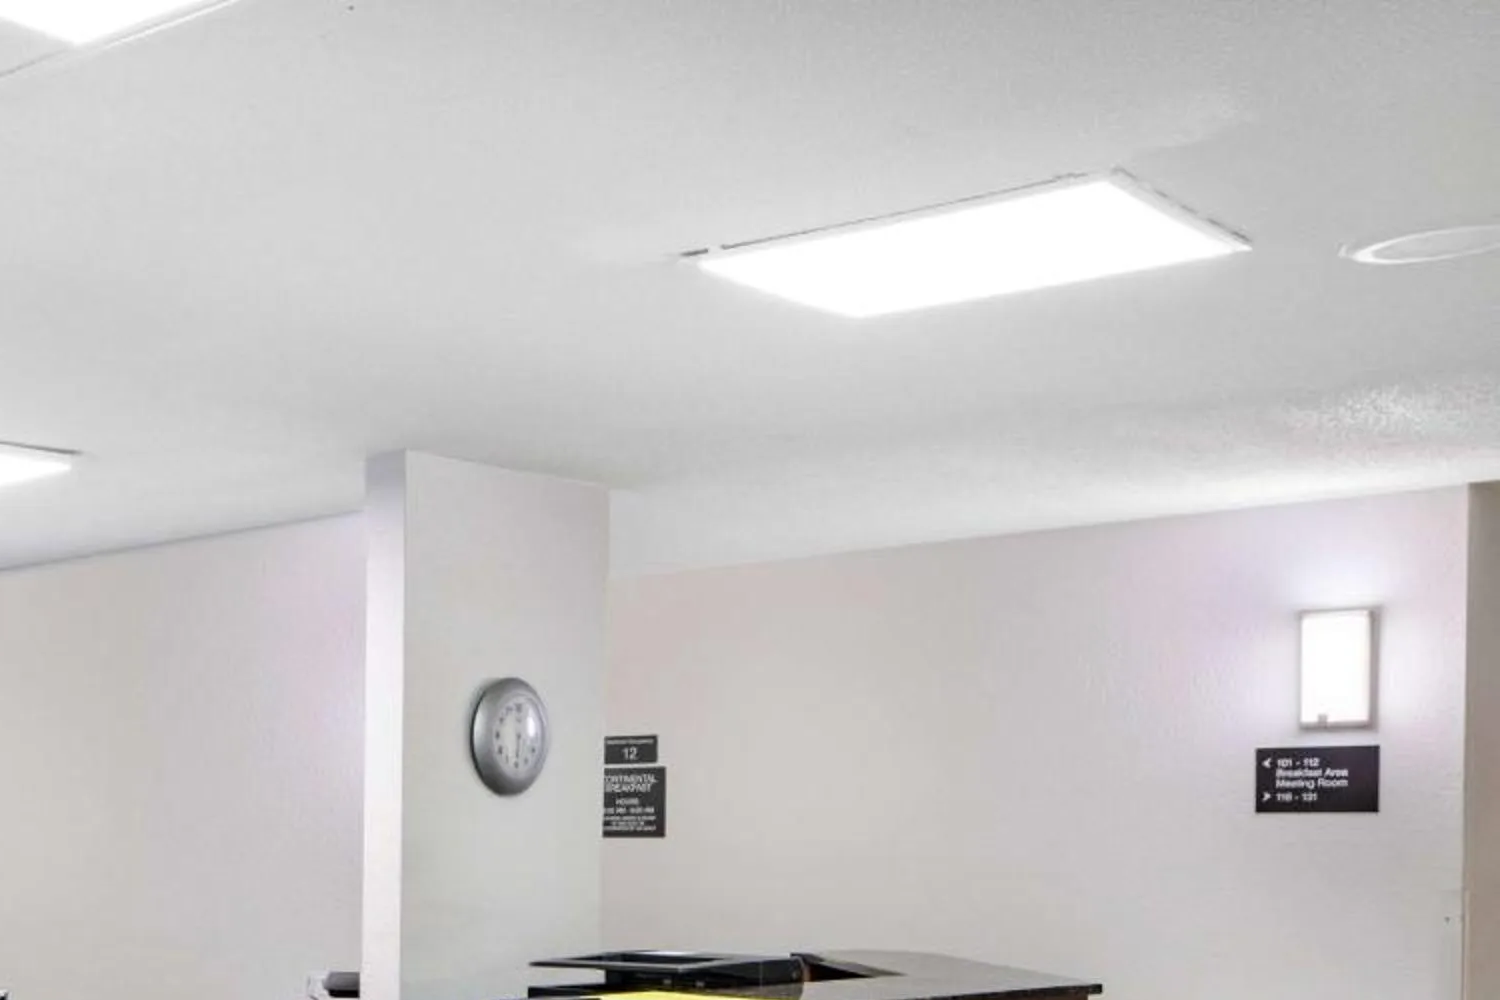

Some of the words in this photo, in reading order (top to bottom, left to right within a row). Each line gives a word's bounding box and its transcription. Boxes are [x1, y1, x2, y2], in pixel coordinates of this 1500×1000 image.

[622, 746, 638, 760] 12
[1275, 768, 1323, 778] Breakfast
[1323, 767, 1349, 778] Area
[1275, 779, 1315, 789] Meeting
[1317, 778, 1349, 788] Room
